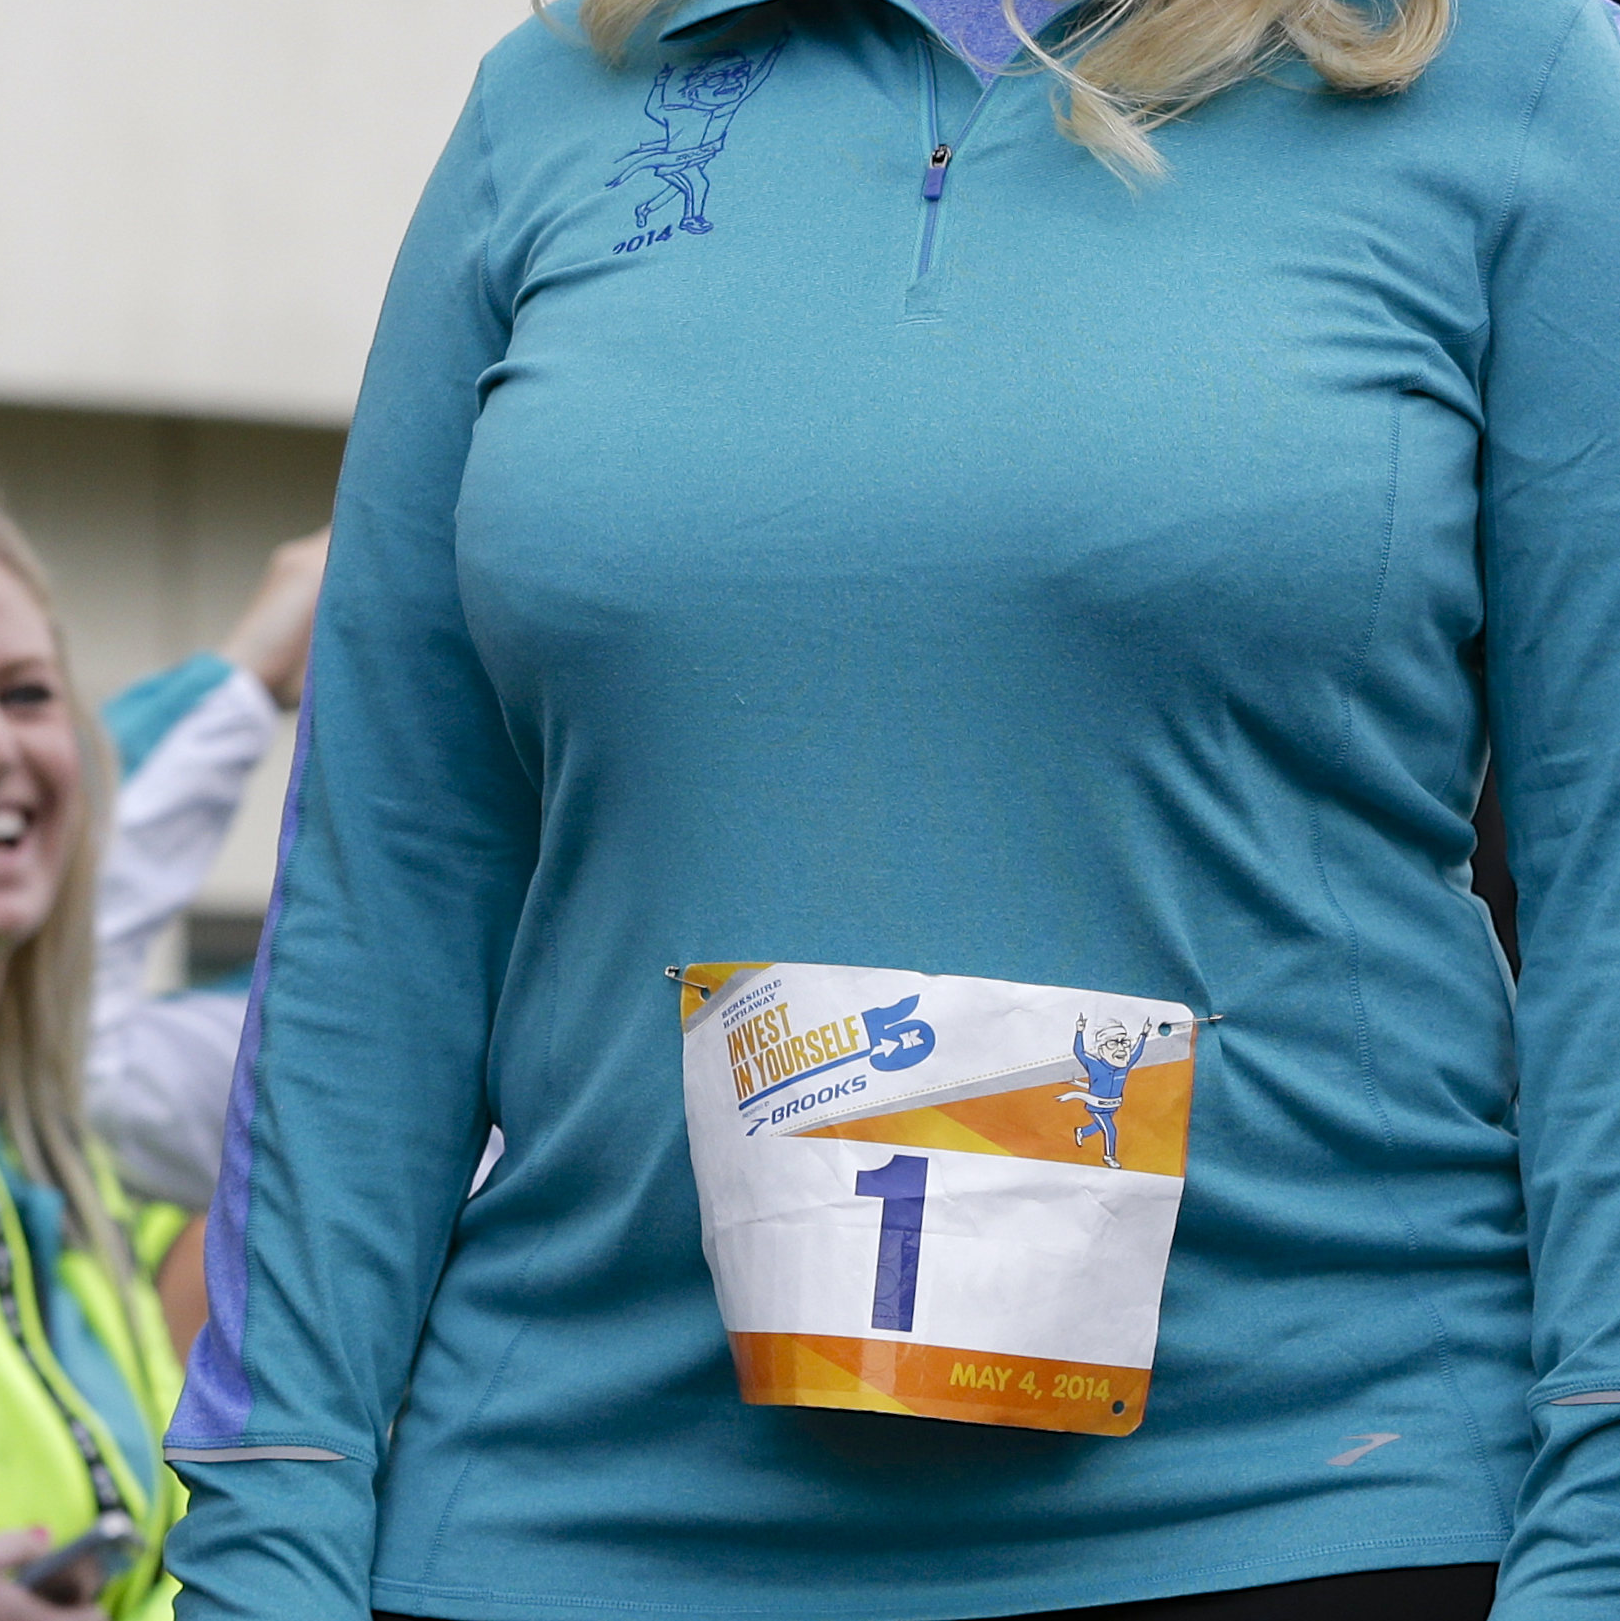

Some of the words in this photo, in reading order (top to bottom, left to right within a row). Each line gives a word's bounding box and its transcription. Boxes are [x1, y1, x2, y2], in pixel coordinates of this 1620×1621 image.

[612, 224, 672, 255] 2014
[721, 979, 782, 1019] BERKSHIRE
[723, 992, 776, 1029] HATHAWAY
[727, 1002, 792, 1067] INVEST
[732, 1061, 755, 1101] IN
[752, 1015, 860, 1087] YOURSELF
[771, 1075, 867, 1125] BROOKS
[855, 1154, 929, 1332] 1
[949, 1362, 1012, 1388] MAY
[1018, 1369, 1045, 1398] 4,
[1052, 1373, 1111, 1402] 2014
